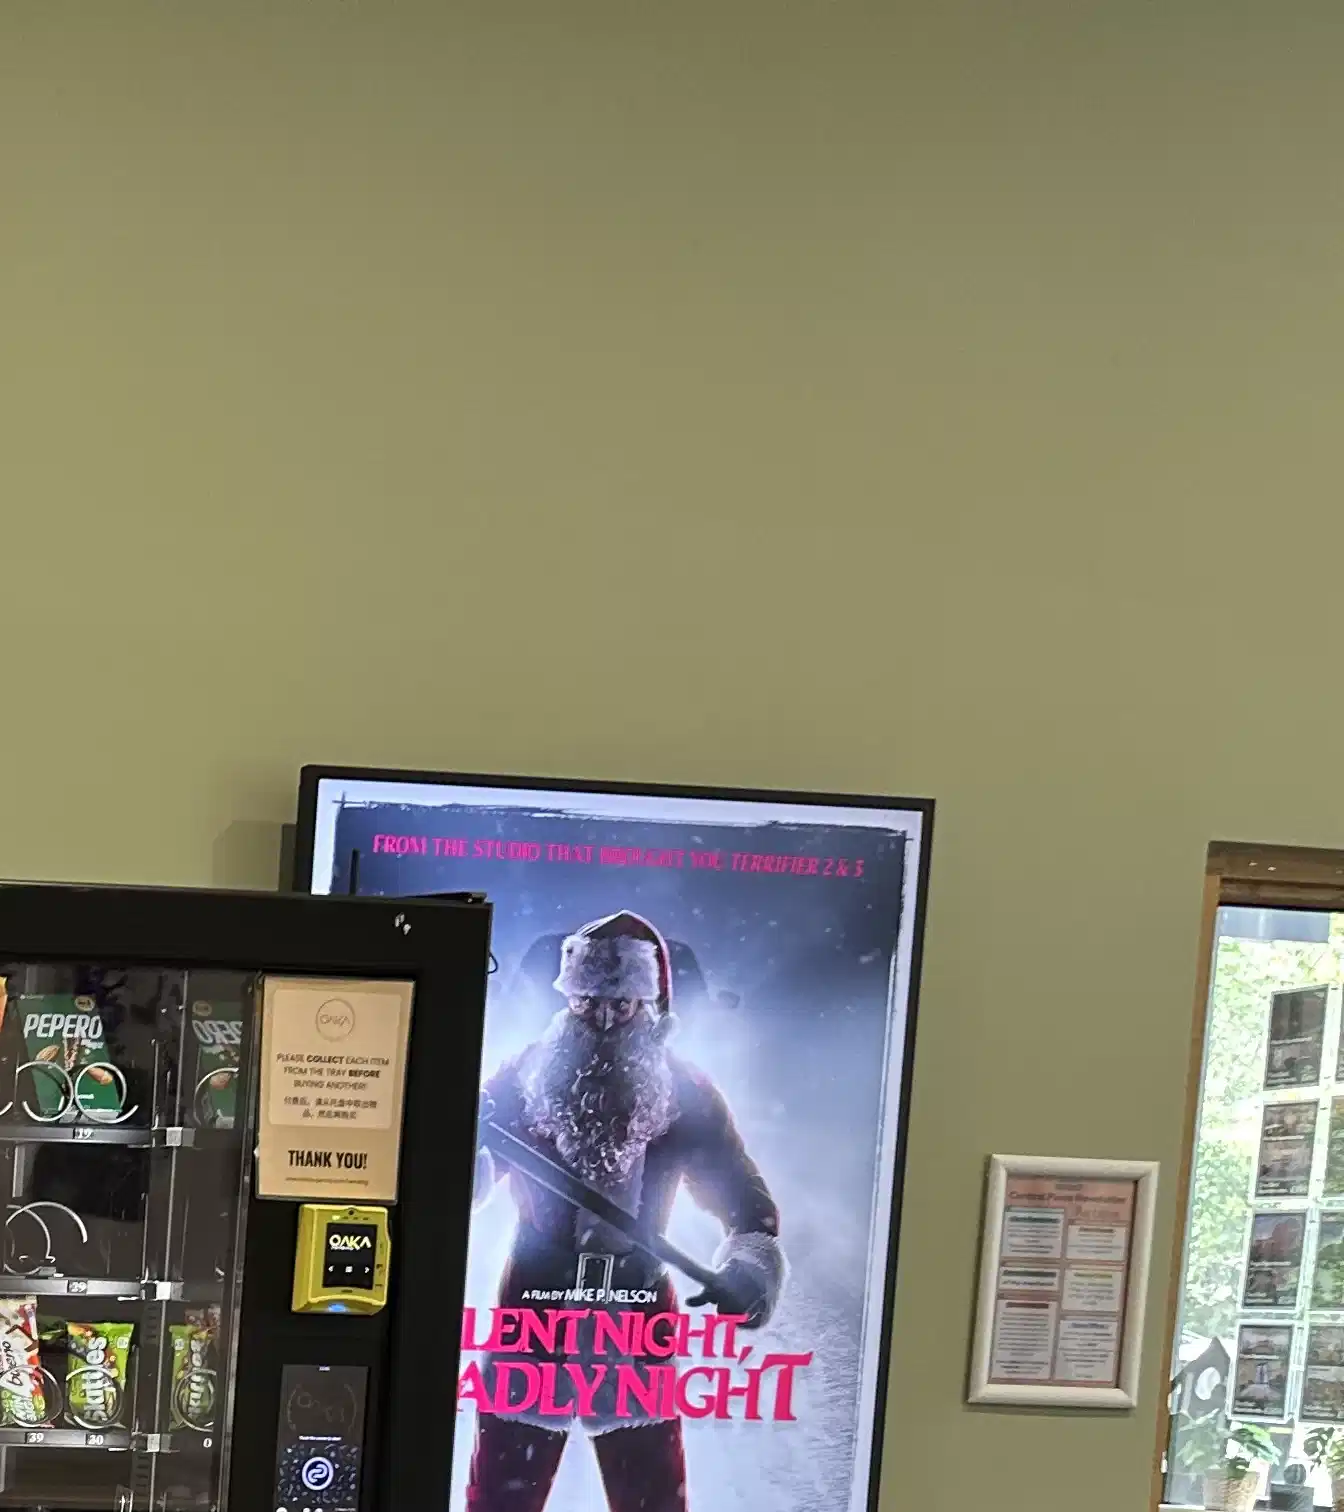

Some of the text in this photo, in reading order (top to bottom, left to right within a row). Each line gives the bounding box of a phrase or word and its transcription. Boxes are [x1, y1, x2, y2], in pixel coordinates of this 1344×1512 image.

[372, 834, 428, 855] FROM
[432, 838, 469, 857] THE
[472, 840, 540, 861] STUDIO
[547, 843, 593, 863] THAT
[731, 853, 818, 875] TERRIFIER
[823, 857, 833, 875] 2
[835, 858, 848, 876] &
[23, 1013, 104, 1039] PEPERO
[276, 1053, 304, 1062] PLEASE
[306, 1055, 344, 1064] COLLECT
[349, 1070, 380, 1078] BEFORE
[75, 1129, 93, 1139] 19
[288, 1150, 368, 1170] THANK YOU!
[328, 1233, 372, 1250] OAKA
[71, 1282, 87, 1292] 29
[522, 1290, 530, 1299] A
[531, 1291, 550, 1300] FILM
[552, 1291, 564, 1301] BY
[564, 1289, 594, 1302] MIKE
[609, 1290, 657, 1303] NELSON
[460, 1307, 753, 1366] LENT NIGHT,
[2, 1341, 24, 1387] bueno
[457, 1352, 813, 1421] ADLY NIGHT
[28, 1432, 44, 1443] 39
